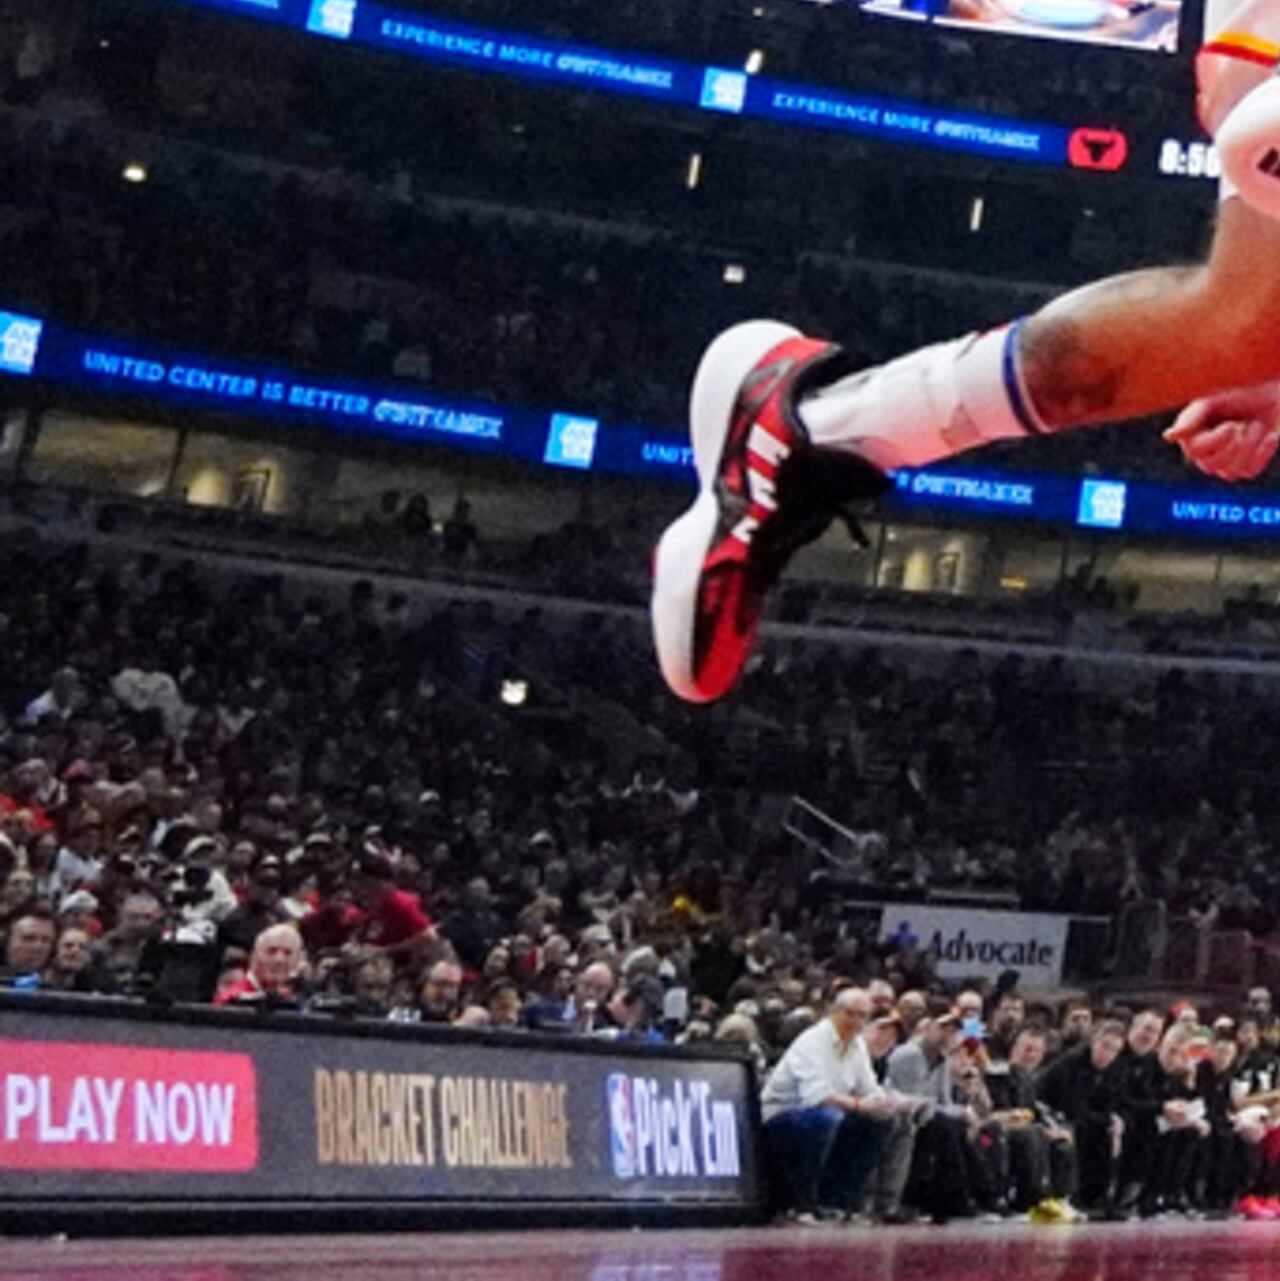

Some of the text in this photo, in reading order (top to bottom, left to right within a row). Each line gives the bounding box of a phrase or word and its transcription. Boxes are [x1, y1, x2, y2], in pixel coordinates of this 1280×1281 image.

[381, 19, 494, 58] EXPERIENCE
[499, 44, 554, 68] MORE
[772, 92, 879, 125] EXPERIENCE
[883, 110, 932, 133] MORE
[85, 349, 164, 382] UNITED
[168, 365, 257, 397] CENTER
[261, 382, 283, 402] IS
[288, 384, 369, 415] BETTER
[642, 441, 695, 467] UNIT
[1172, 500, 1245, 523] UNITED
[931, 928, 1053, 967] Advocate
[6, 1073, 234, 1146] PLAY NOW
[315, 1069, 571, 1169] BRACKET CHALLENGE
[631, 1074, 741, 1178] Pick'Em
